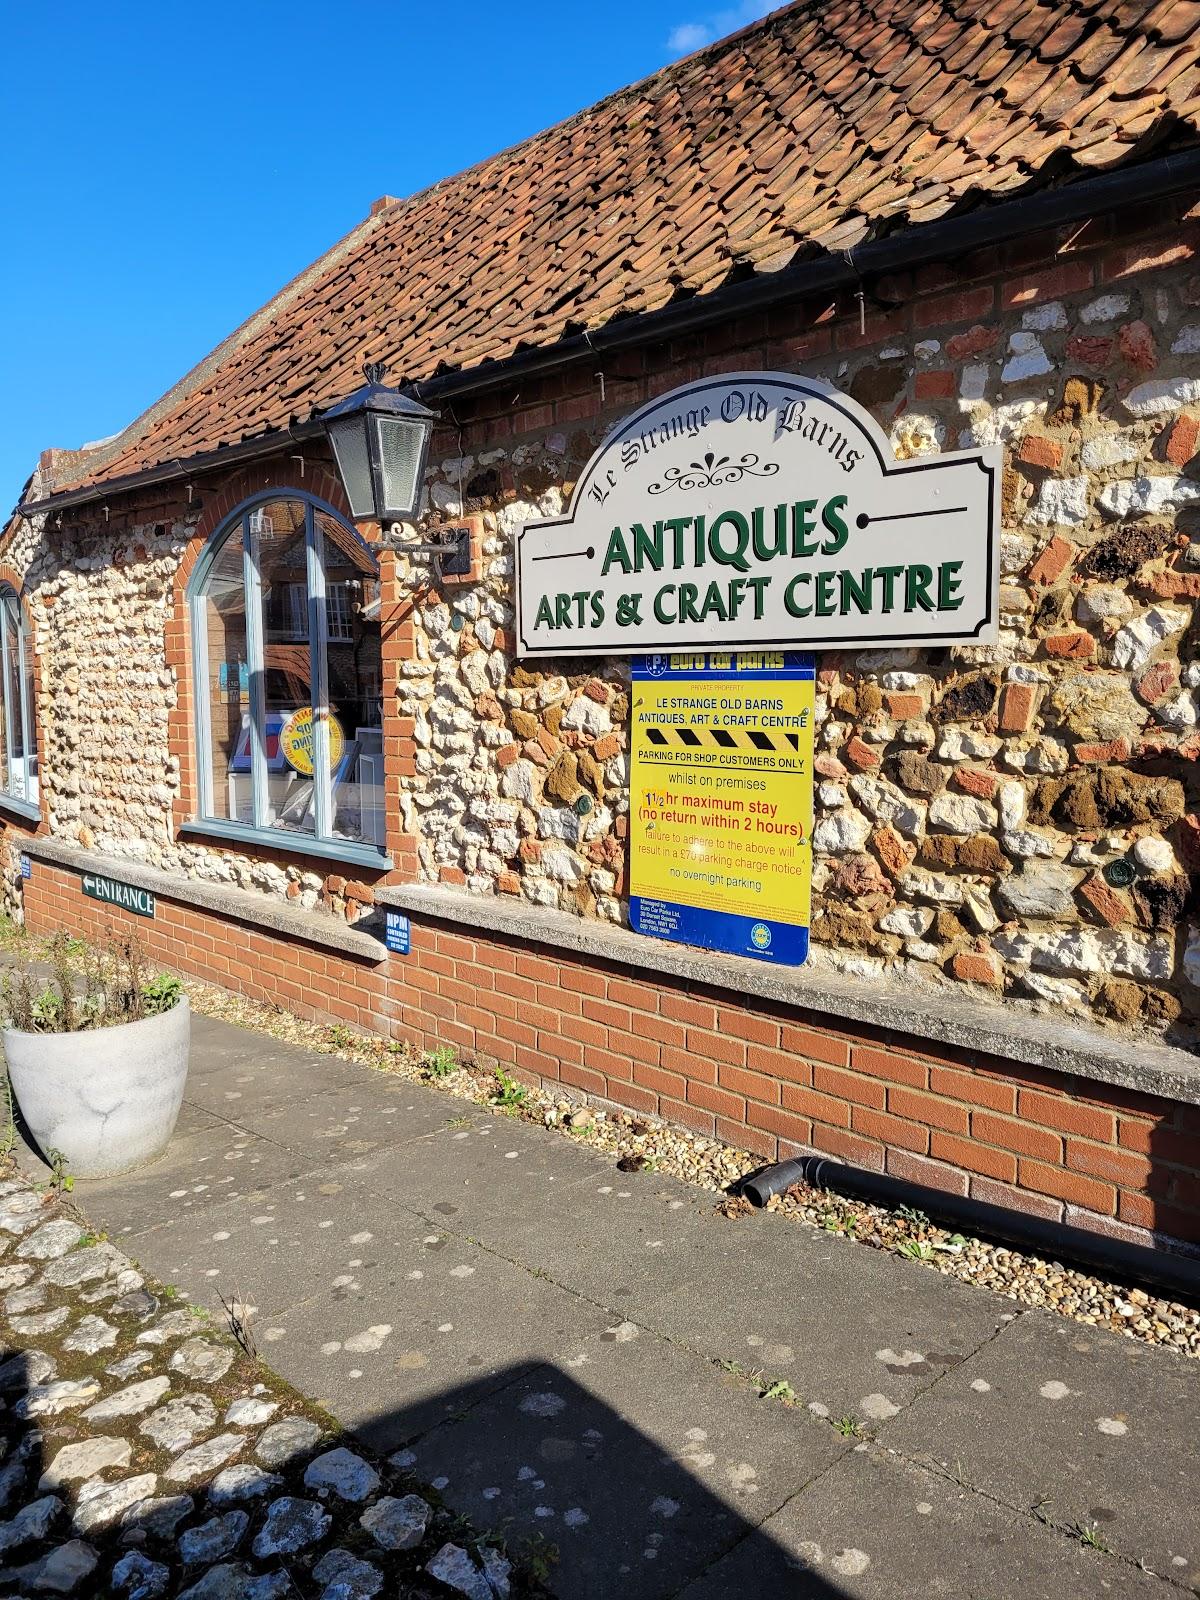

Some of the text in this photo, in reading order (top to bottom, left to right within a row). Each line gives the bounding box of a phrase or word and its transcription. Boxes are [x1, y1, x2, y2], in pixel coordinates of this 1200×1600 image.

[588, 390, 865, 507] Le Strange Old Barns
[601, 495, 849, 576] ANTIQUES
[534, 560, 964, 631] ARTS & CRAFT CENTRE
[657, 698, 783, 710] LE STRANGE OLD BARNS
[639, 714, 807, 727] ANTIQUES, ART & CRAFT CENTRE
[639, 751, 804, 769] PARKING FOR SHOP CUSTOMERS ONLY
[669, 773, 766, 790] whilst on premises
[666, 792, 678, 805] hr
[683, 794, 744, 812] maximum
[749, 797, 777, 817] stay
[639, 807, 803, 839] (no return within 2 hours)
[645, 829, 794, 857] failure to adhere to the above will
[638, 845, 660, 857] result
[662, 847, 669, 858] in
[672, 850, 678, 858] a
[698, 850, 732, 868] parking
[735, 857, 768, 872] charge
[771, 861, 801, 876] notice
[670, 868, 761, 891] no overnight parking
[95, 877, 154, 914] ENTRANCE
[386, 913, 408, 931] NPM
